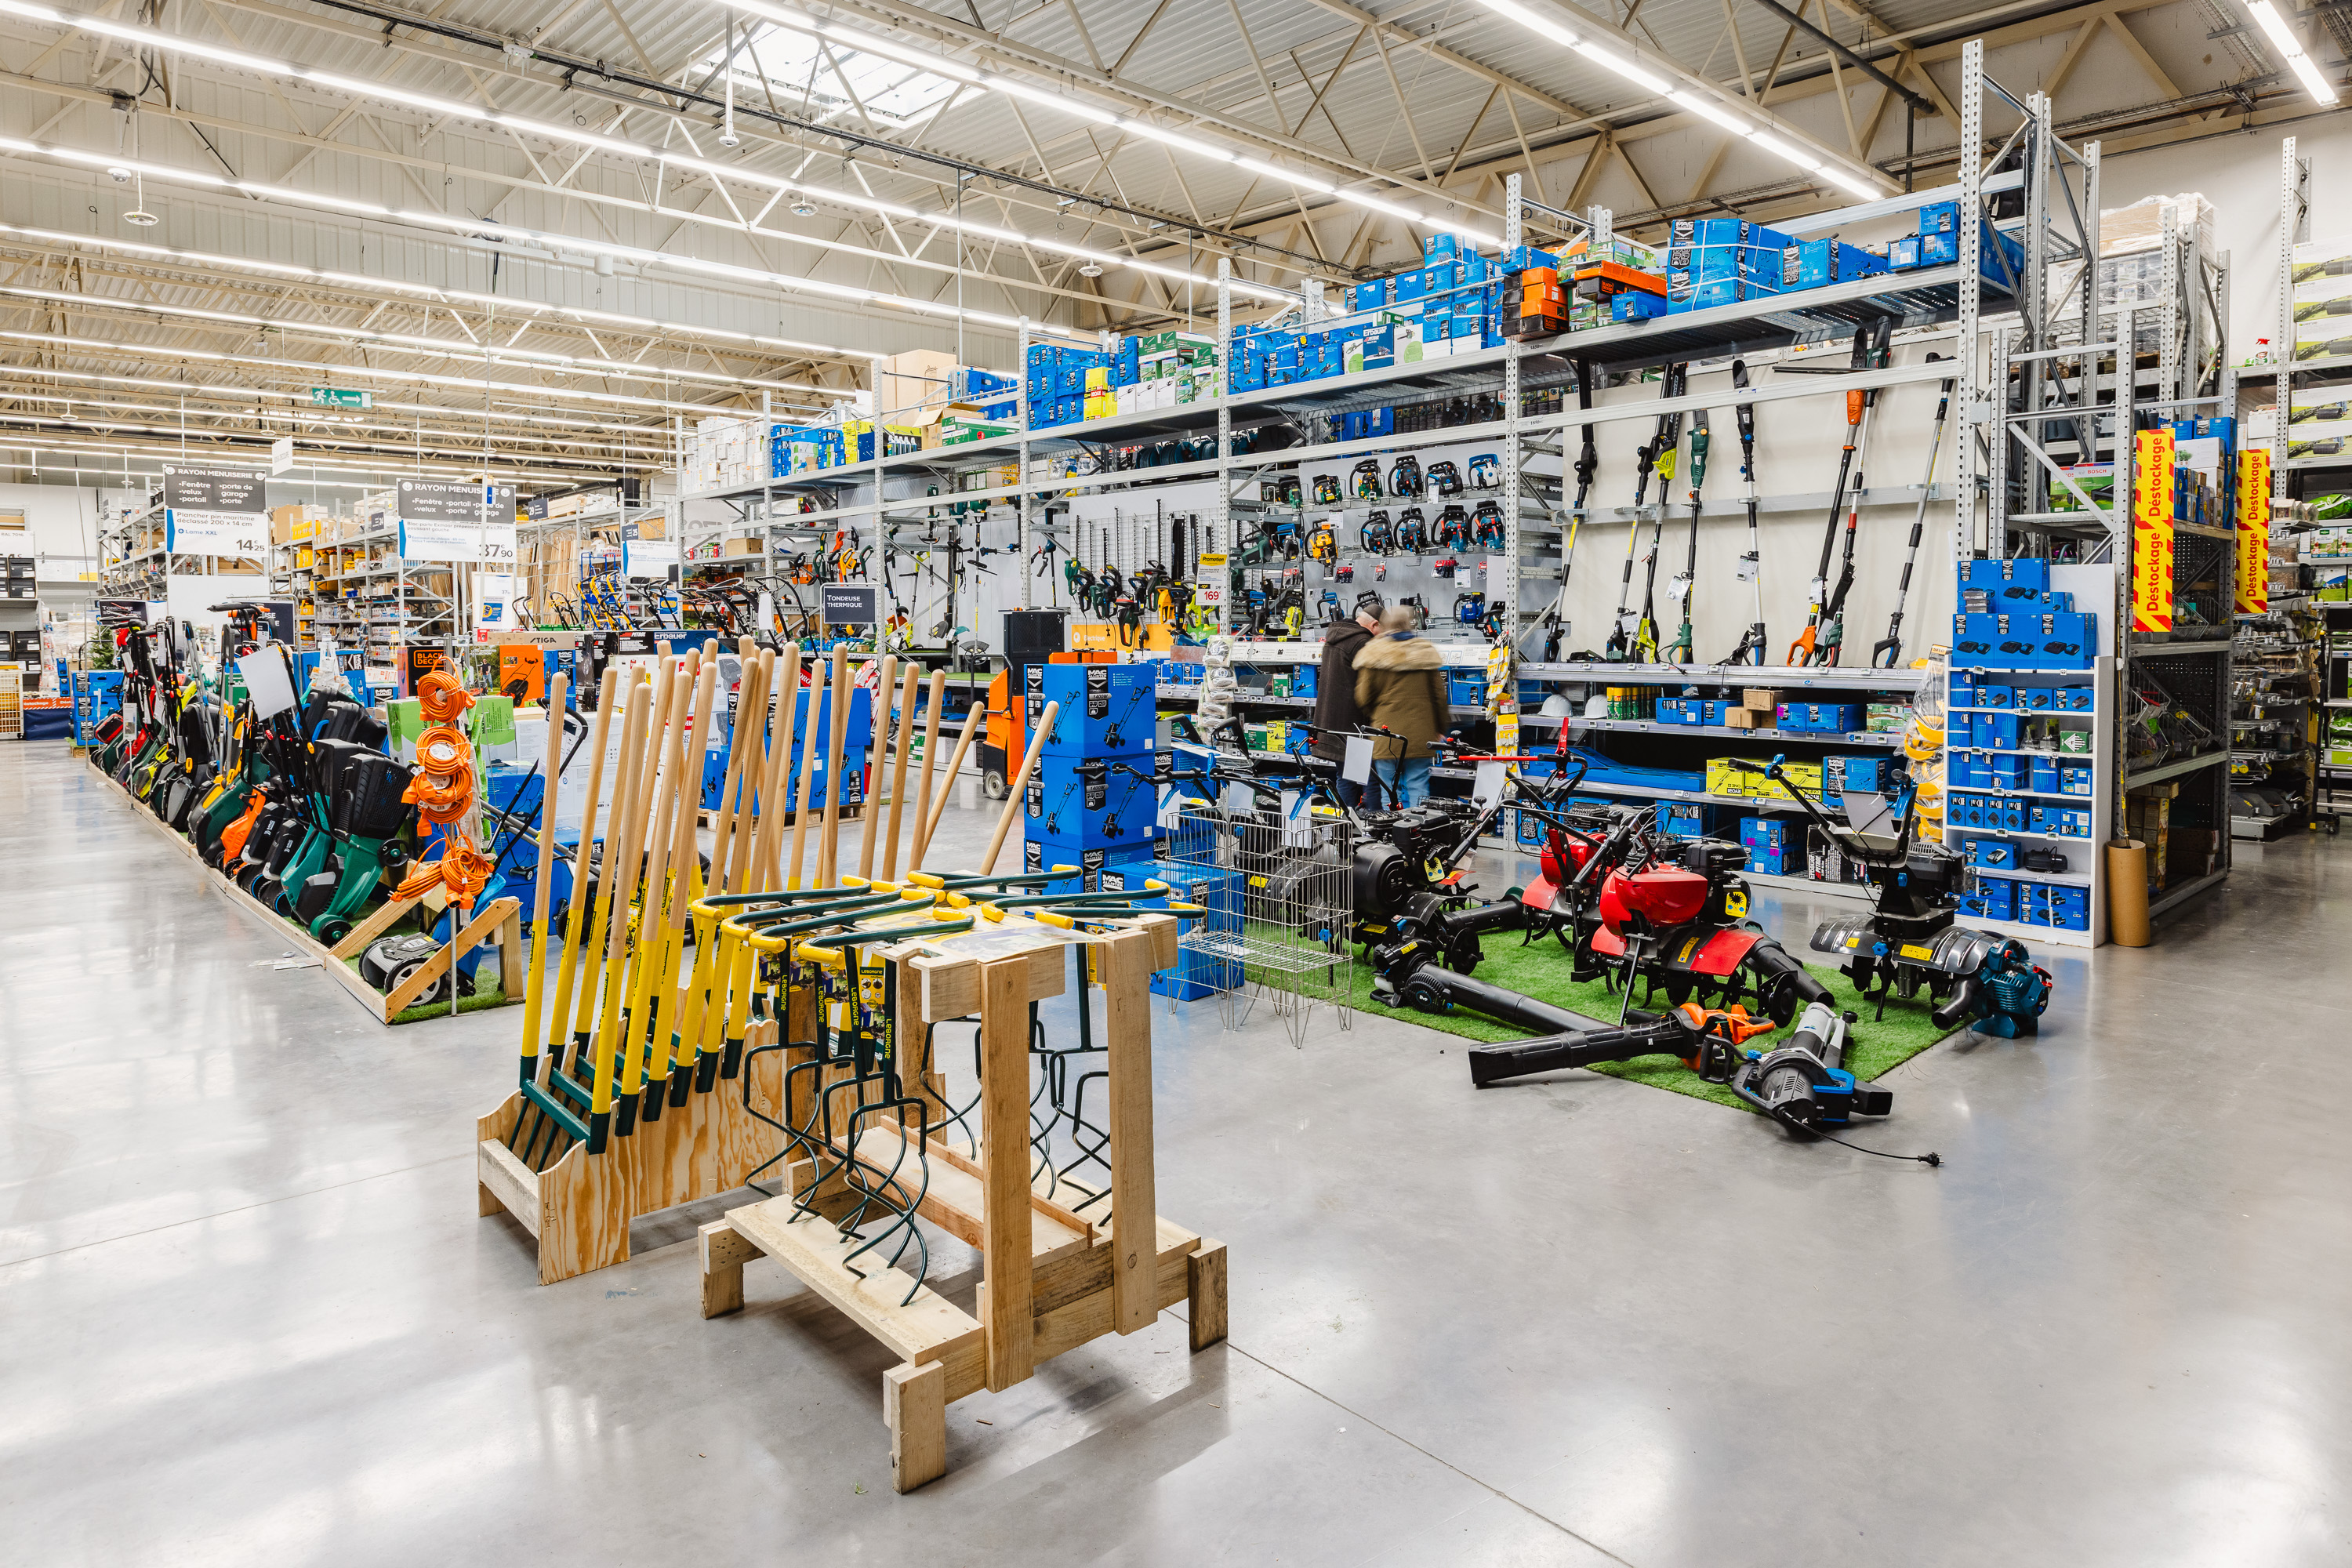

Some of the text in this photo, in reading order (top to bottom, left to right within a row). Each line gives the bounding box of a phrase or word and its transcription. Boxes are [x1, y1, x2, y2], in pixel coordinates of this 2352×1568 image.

[208, 470, 253, 479] MENUISERIE
[2149, 437, 2165, 517] Déstockage
[415, 484, 446, 492] RAYON
[2248, 456, 2262, 520] Déstockage
[415, 497, 442, 506] Fenêtre
[529, 506, 535, 515] 29
[236, 539, 253, 551] 14
[2246, 533, 2260, 597] Déstockage
[2147, 533, 2163, 612] Déstockage
[1204, 590, 1219, 601] 169
[1102, 874, 1123, 884] MAC
